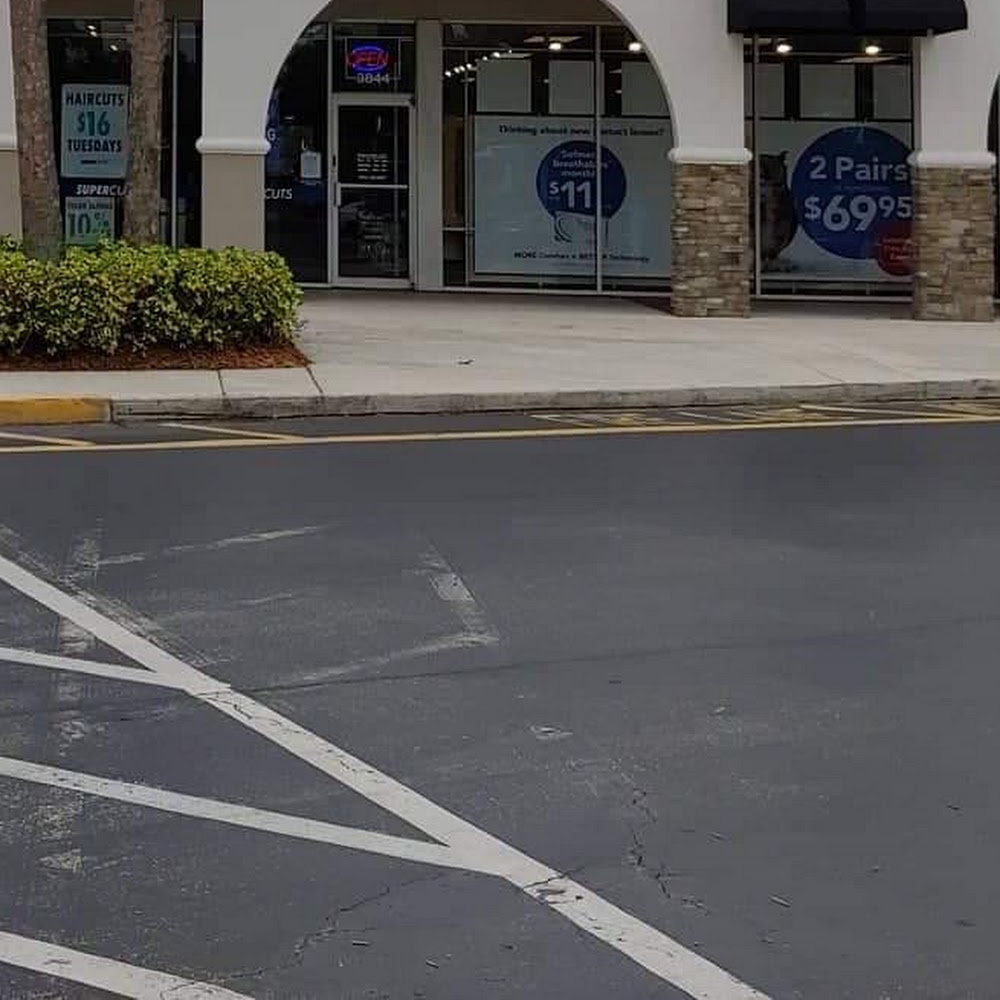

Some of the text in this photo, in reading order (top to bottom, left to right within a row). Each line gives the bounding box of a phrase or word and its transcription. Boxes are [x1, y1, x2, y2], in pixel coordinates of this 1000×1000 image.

[65, 92, 124, 106] HAIRCUTS
[77, 111, 111, 136] $16
[67, 139, 122, 152] TUESDAYS
[810, 156, 908, 180] 2 Pairs
